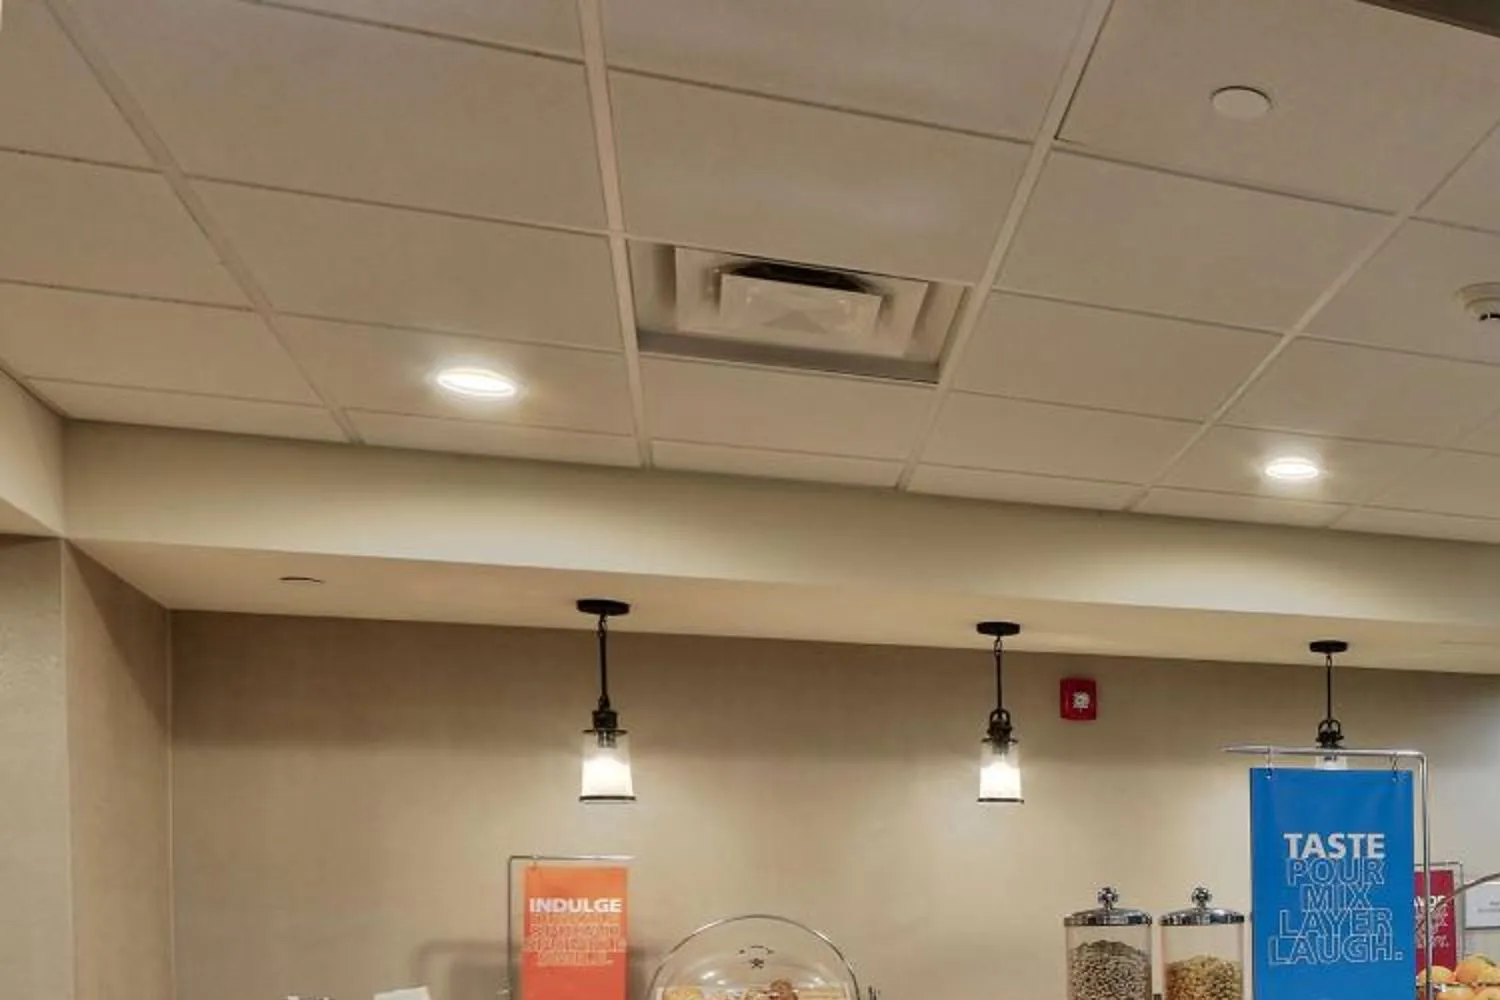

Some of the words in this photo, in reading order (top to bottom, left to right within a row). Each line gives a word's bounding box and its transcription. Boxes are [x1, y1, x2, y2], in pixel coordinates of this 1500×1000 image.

[1283, 833, 1386, 859] TASTE
[1286, 858, 1385, 885] POUR
[529, 897, 623, 913] INDULGE
[1301, 882, 1372, 910] MIX
[1279, 908, 1393, 938] LAYER
[1268, 934, 1403, 964] LAUGH.
